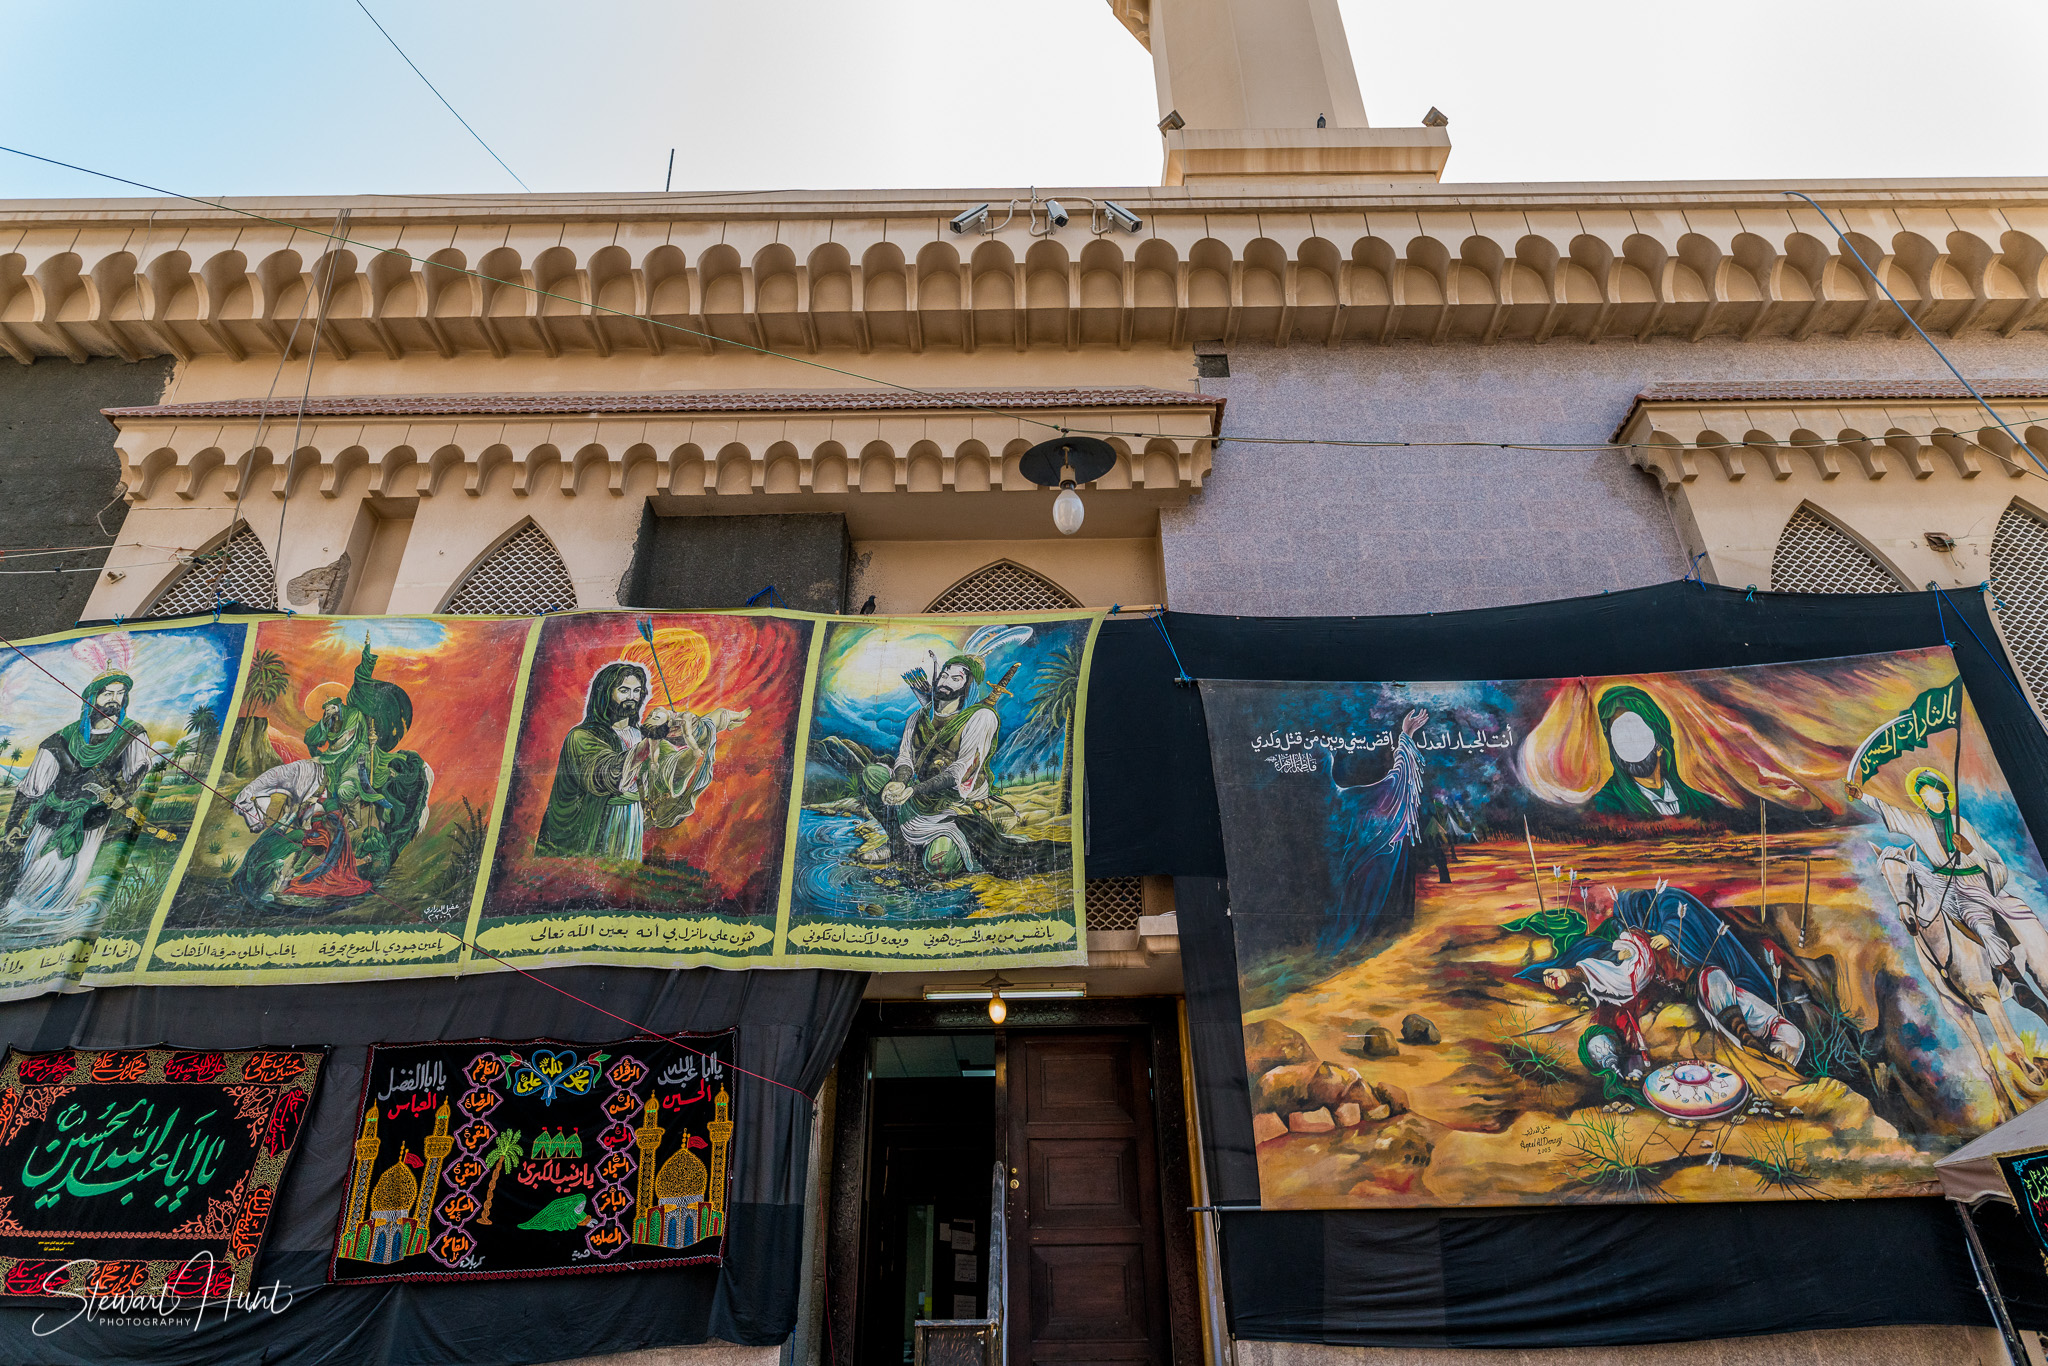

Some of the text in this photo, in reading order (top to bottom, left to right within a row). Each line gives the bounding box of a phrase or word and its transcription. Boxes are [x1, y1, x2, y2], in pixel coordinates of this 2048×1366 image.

[1319, 734, 1345, 752] وبين
[1344, 732, 1367, 754] بيني
[1416, 730, 1451, 751] العدل
[1450, 729, 1487, 754] الجبار
[1486, 723, 1513, 748] أنت
[1861, 725, 1897, 775] الحسين
[530, 926, 565, 942] تعالى
[567, 923, 595, 938] الله
[598, 925, 629, 939] بعين
[636, 923, 660, 938] أنه
[662, 927, 679, 944] بي
[709, 928, 729, 944] علي
[802, 928, 832, 946] تكوني
[831, 928, 846, 943] أن
[948, 929, 981, 948] الحسين
[980, 933, 997, 944] بعد
[997, 934, 1015, 944] من
[382, 941, 419, 957] جودي
[880, 935, 910, 949] وبعده
[923, 933, 950, 949] هوني
[667, 1054, 693, 1076] الله
[378, 1062, 426, 1101] الفضل
[657, 1067, 699, 1089] عبد
[662, 1077, 712, 1113] الحسين
[387, 1091, 437, 1120] العباس
[550, 1163, 583, 1194] زينب
